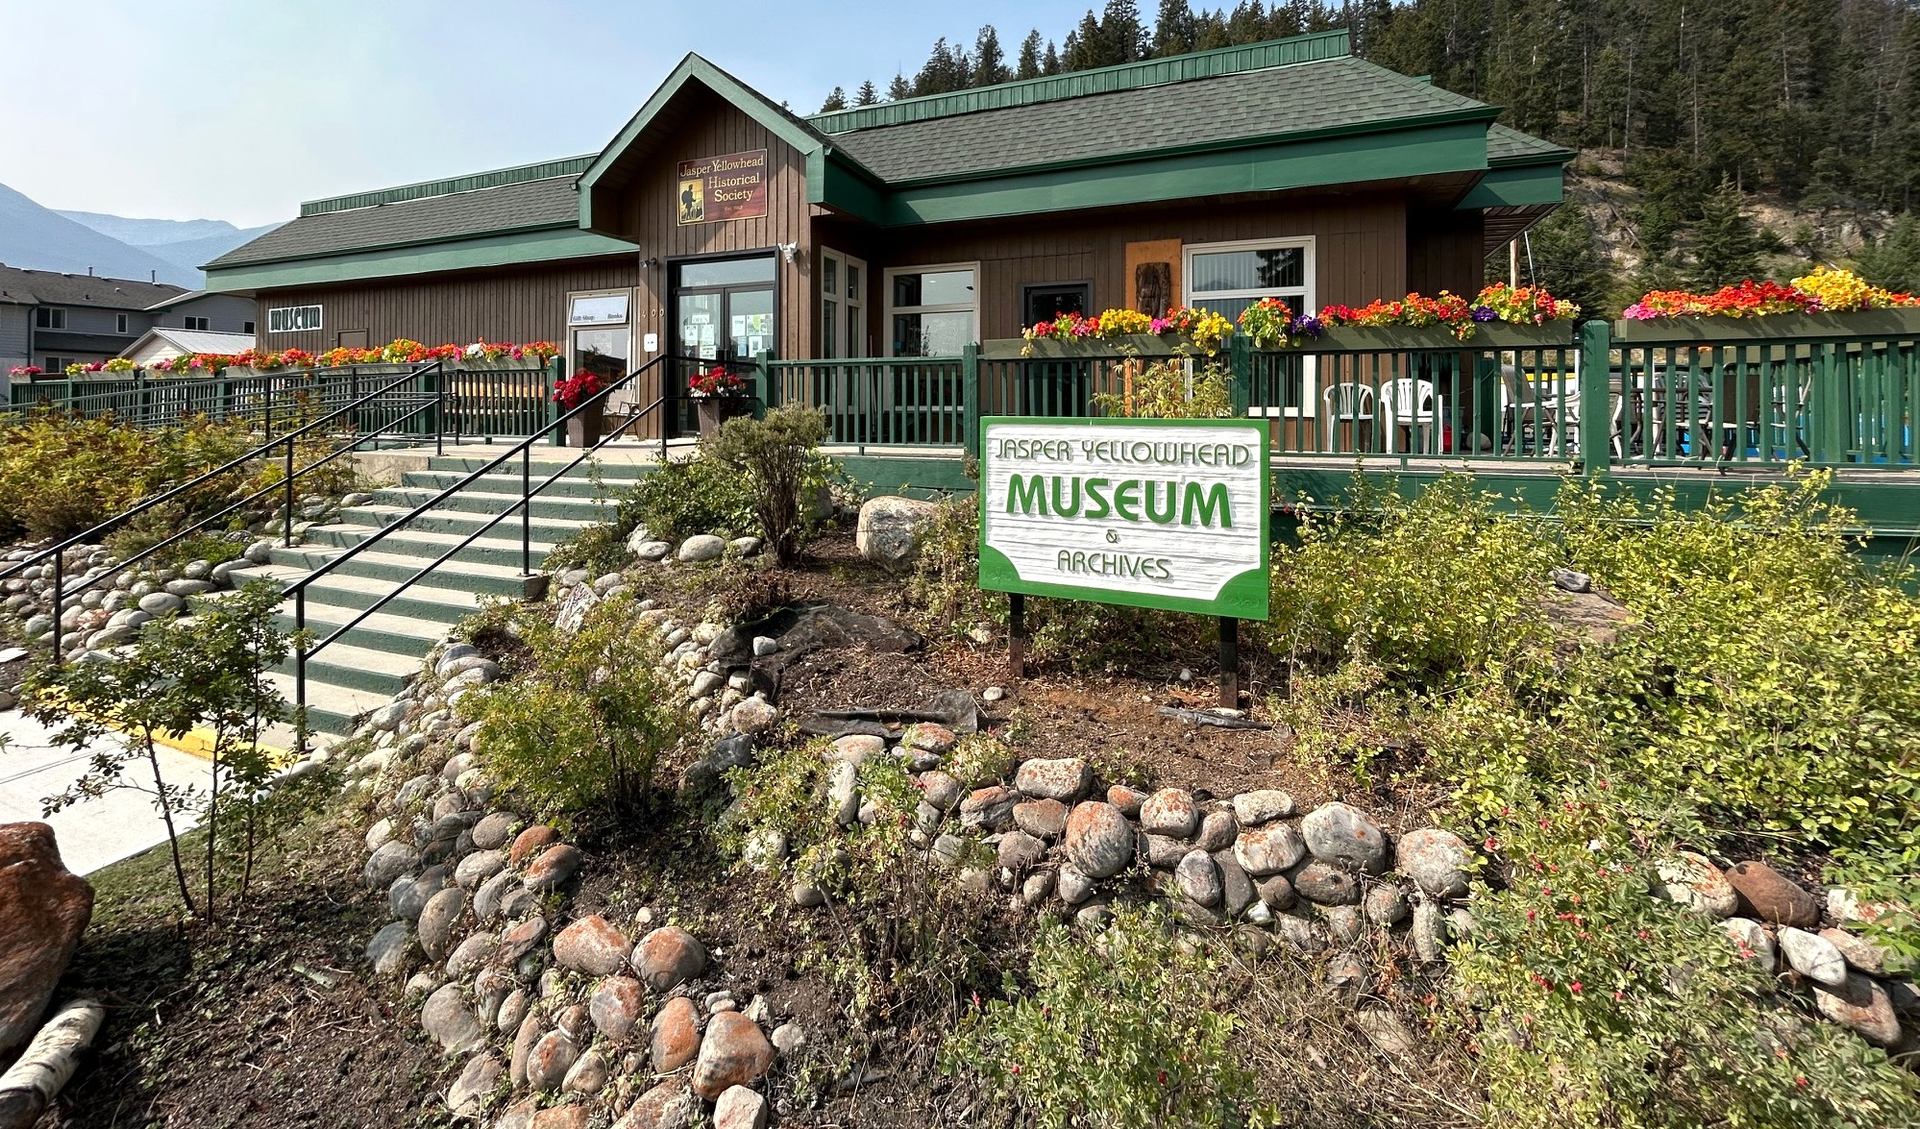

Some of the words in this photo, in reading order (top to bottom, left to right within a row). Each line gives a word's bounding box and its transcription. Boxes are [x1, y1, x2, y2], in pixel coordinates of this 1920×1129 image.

[680, 165, 711, 178] Jasper
[712, 154, 764, 172] Yellowhead
[708, 172, 760, 189] Historical
[714, 189, 753, 203] Society
[996, 438, 1071, 461] JASPER
[1081, 440, 1250, 466] YELLOWHEAD
[1006, 473, 1233, 528] MUSEUM
[1105, 529, 1118, 544] &
[1057, 549, 1171, 580] ARCHIVES
